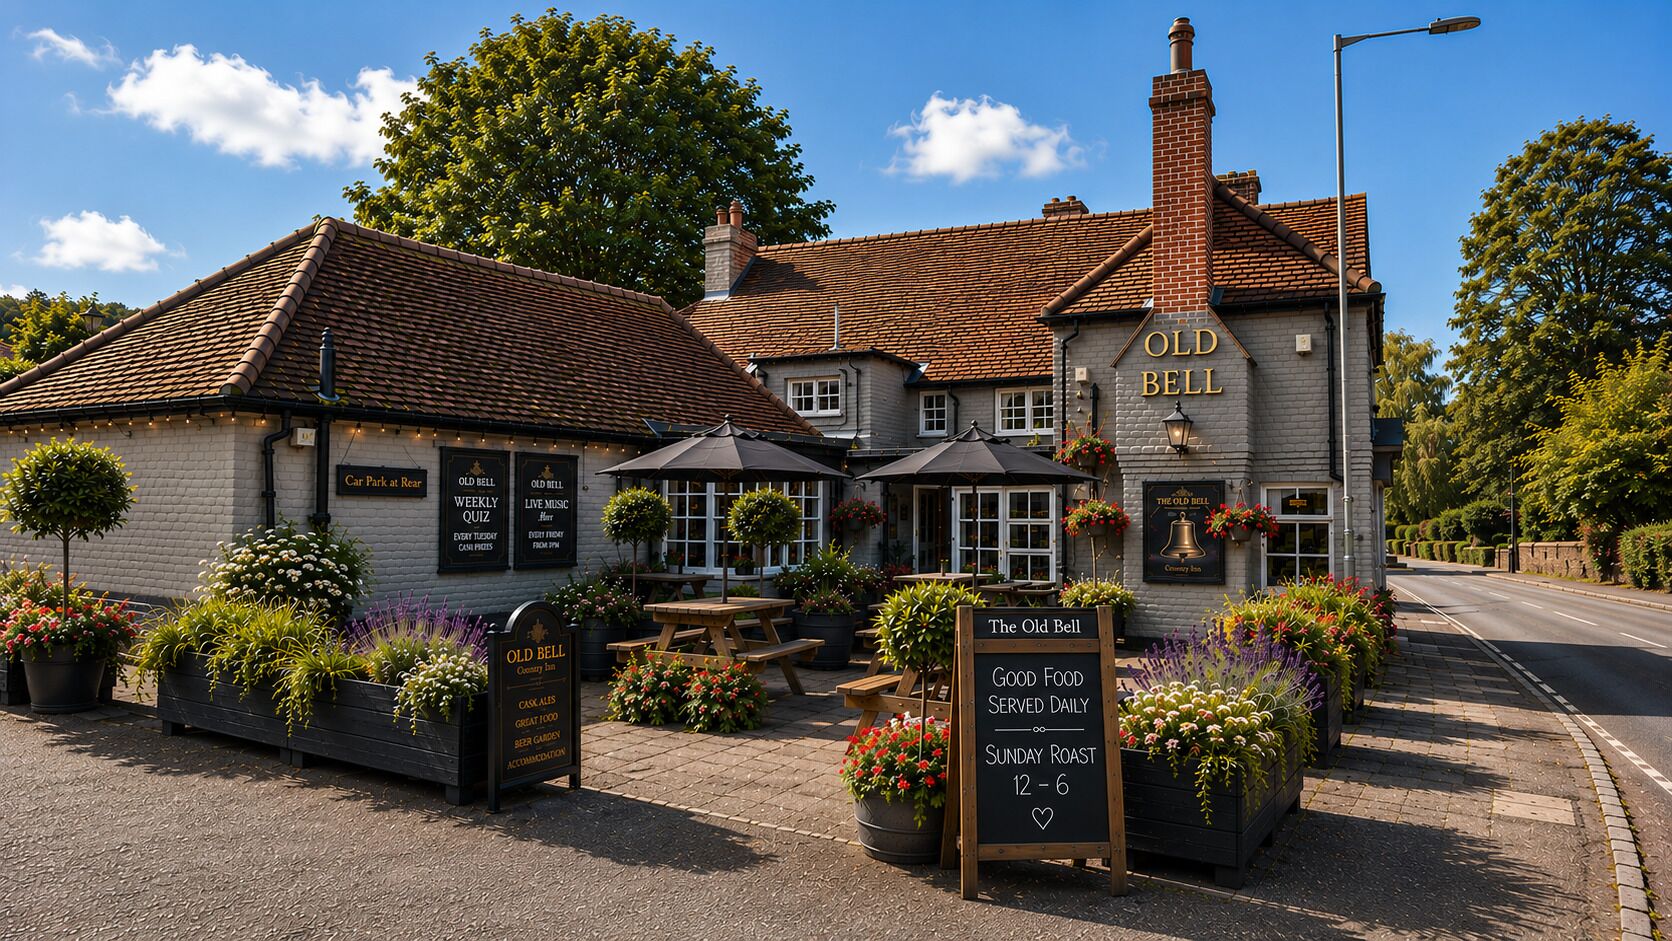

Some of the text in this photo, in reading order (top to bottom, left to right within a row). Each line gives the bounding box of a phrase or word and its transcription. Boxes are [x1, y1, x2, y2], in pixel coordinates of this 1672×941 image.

[1144, 328, 1219, 357] OLD
[1141, 368, 1223, 396] BELL
[345, 474, 422, 488] Car Park at Rear
[458, 477, 496, 487] OLD BELL
[531, 479, 564, 489] OLD BELL
[454, 496, 499, 508] WEEKLY
[525, 498, 569, 509] LIVE MUSIC
[1156, 497, 1210, 505] THE OLD BELL
[462, 510, 490, 524] QUIZ
[453, 532, 498, 541] EVERY TUESDAY
[988, 618, 1081, 634] The Old Bell
[506, 644, 566, 663] OLD BELL
[516, 662, 556, 675] Country Inn
[992, 666, 1084, 687] GOOD FOOD
[518, 695, 556, 710] CASK ALES
[988, 695, 1090, 714] SERVED DAILY
[515, 715, 539, 728] GREAT
[514, 730, 561, 749] BEER GARDEN
[985, 744, 1096, 765] SUNDAY ROAST
[1013, 774, 1032, 796] 12
[1056, 773, 1069, 796] 6
